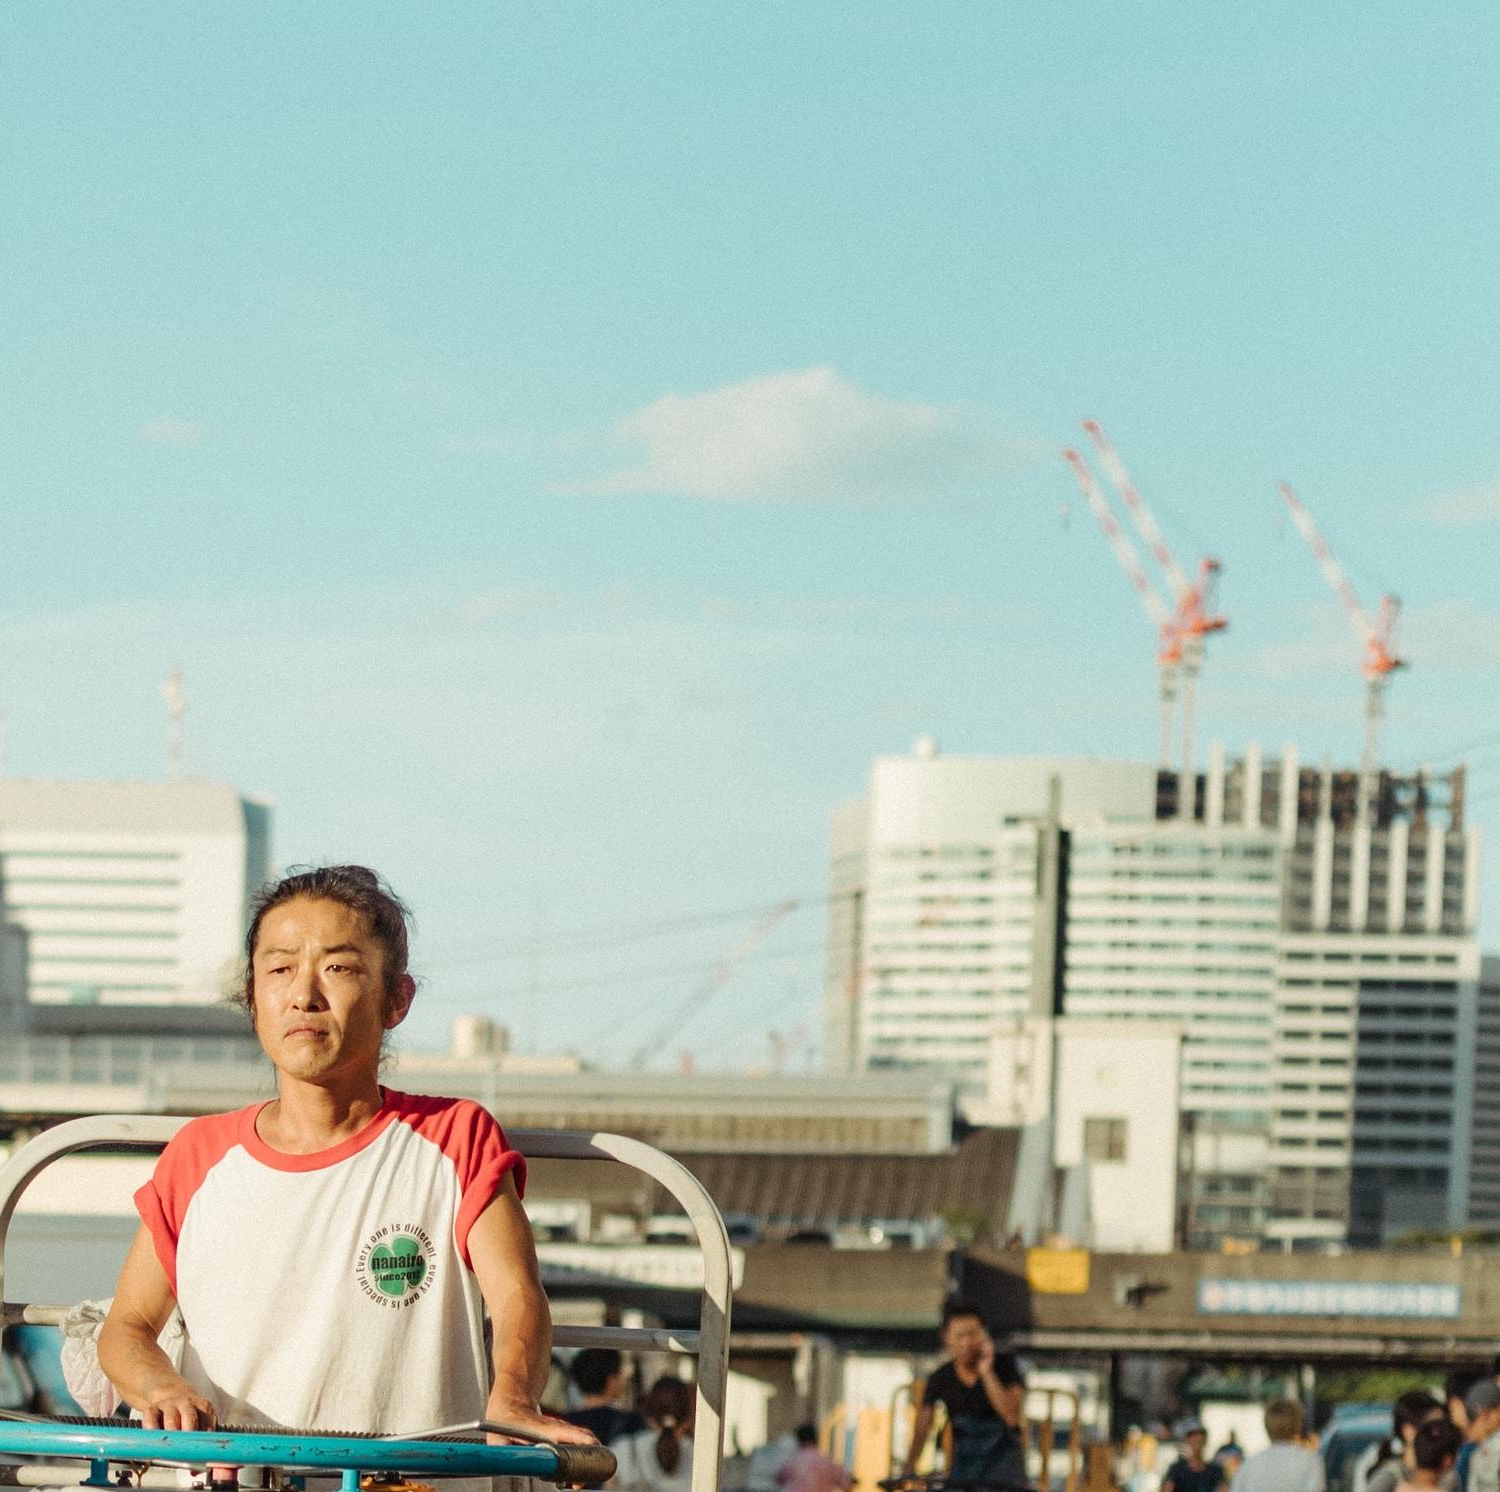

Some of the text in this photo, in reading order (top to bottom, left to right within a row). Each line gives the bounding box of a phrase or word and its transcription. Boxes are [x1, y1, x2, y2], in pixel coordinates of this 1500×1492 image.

[370, 1227, 388, 1243] one
[391, 1223, 401, 1232] is
[356, 1243, 372, 1272] Every
[371, 1253, 424, 1270] nanairo
[419, 1264, 437, 1293] every
[391, 1300, 400, 1310] is
[403, 1292, 420, 1307] one
